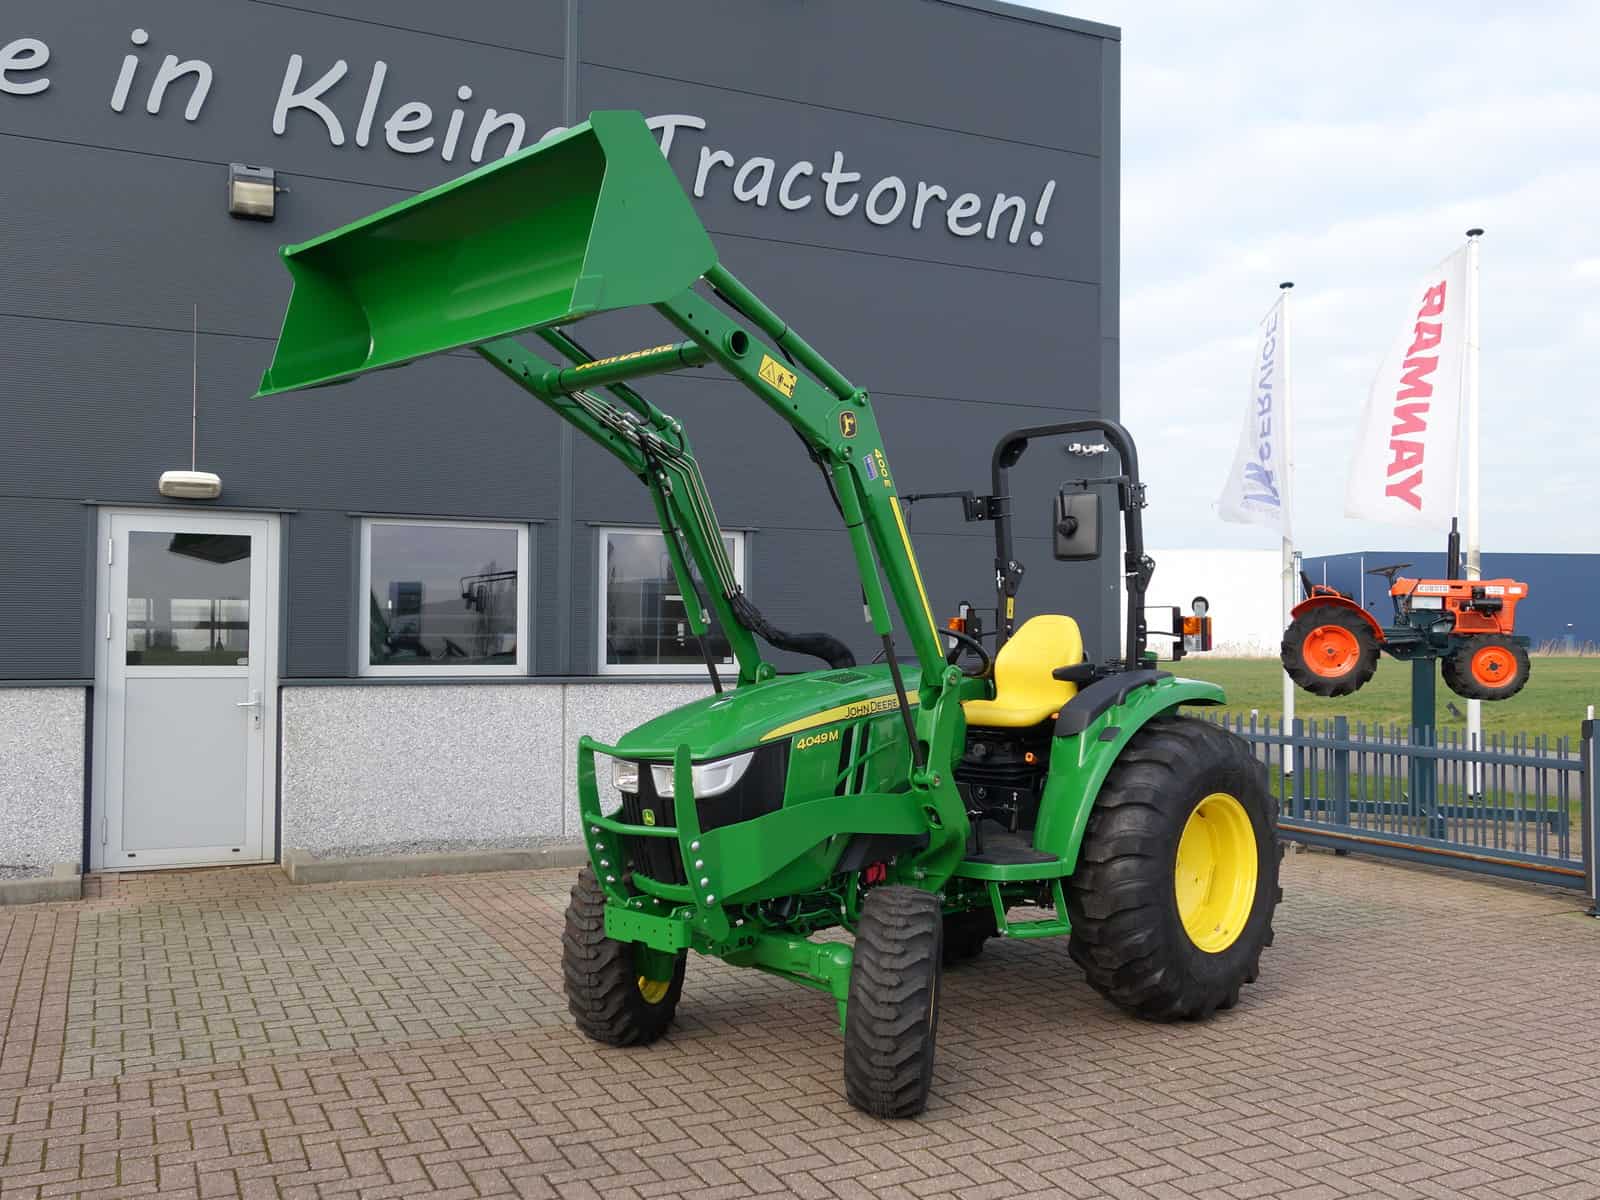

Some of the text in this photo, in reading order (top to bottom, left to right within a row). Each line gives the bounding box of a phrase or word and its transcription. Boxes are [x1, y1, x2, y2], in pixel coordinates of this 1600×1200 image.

[0, 28, 1056, 247] e in Klein Tractoren!
[845, 698, 898, 718] JOHN DEERE
[796, 730, 839, 750] 4049M
